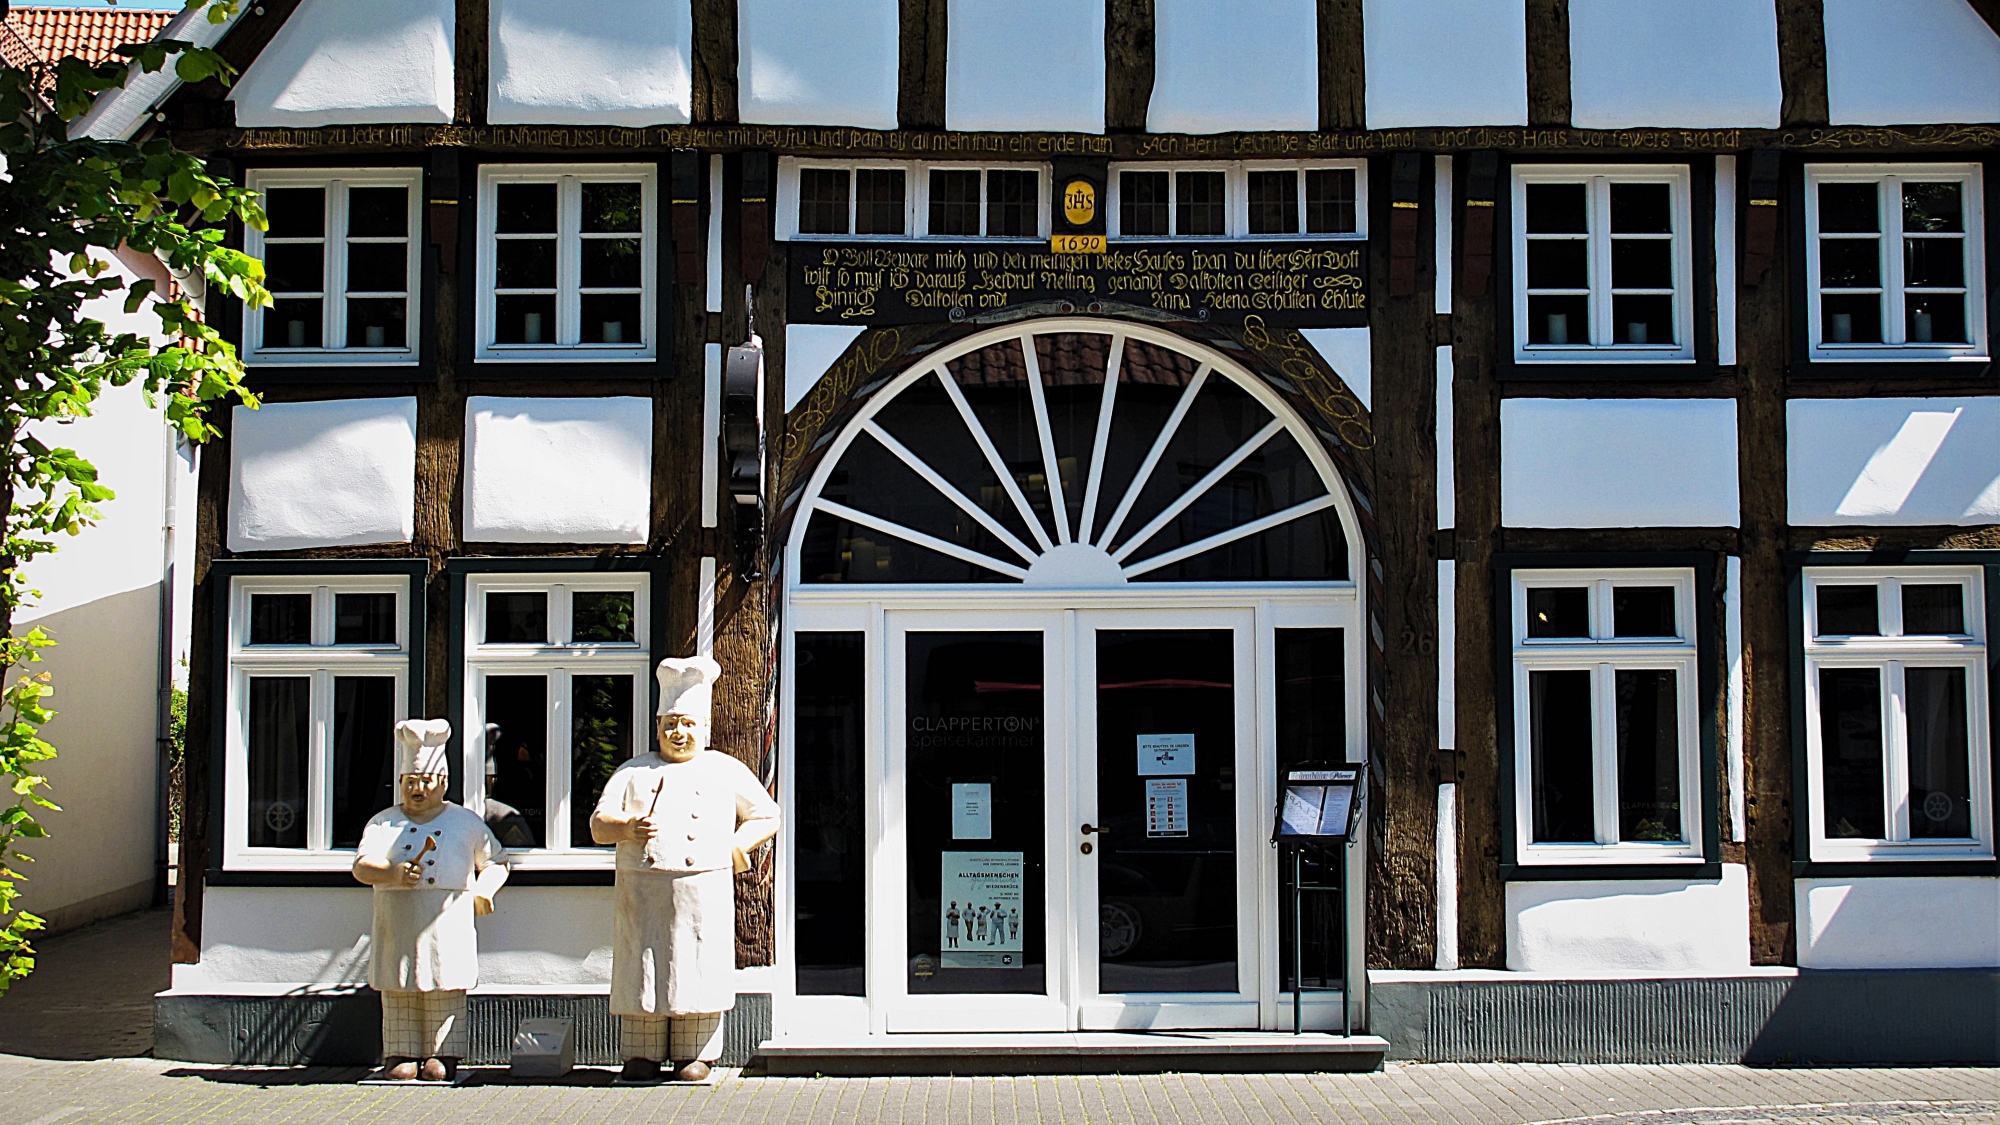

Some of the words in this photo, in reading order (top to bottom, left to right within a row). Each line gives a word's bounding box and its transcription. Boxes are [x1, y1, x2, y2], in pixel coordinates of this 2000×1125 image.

[328, 129, 346, 146] zu
[350, 126, 385, 146] jeder
[493, 127, 507, 145] in
[728, 127, 751, 146] mir
[756, 127, 781, 148] bey
[912, 132, 930, 151] all
[933, 132, 970, 151] mein
[1010, 134, 1032, 152] ein
[1037, 134, 1075, 153] ende
[1345, 133, 1374, 150] und
[1522, 129, 1568, 148] Haus
[1579, 130, 1605, 147] vor
[1059, 236, 1100, 252] 1690
[935, 249, 967, 271] mich
[973, 250, 999, 270] und
[1002, 250, 1028, 270] den
[1235, 251, 1255, 270] du
[1400, 630, 1436, 657] 26
[912, 730, 1036, 751] speisekammer
